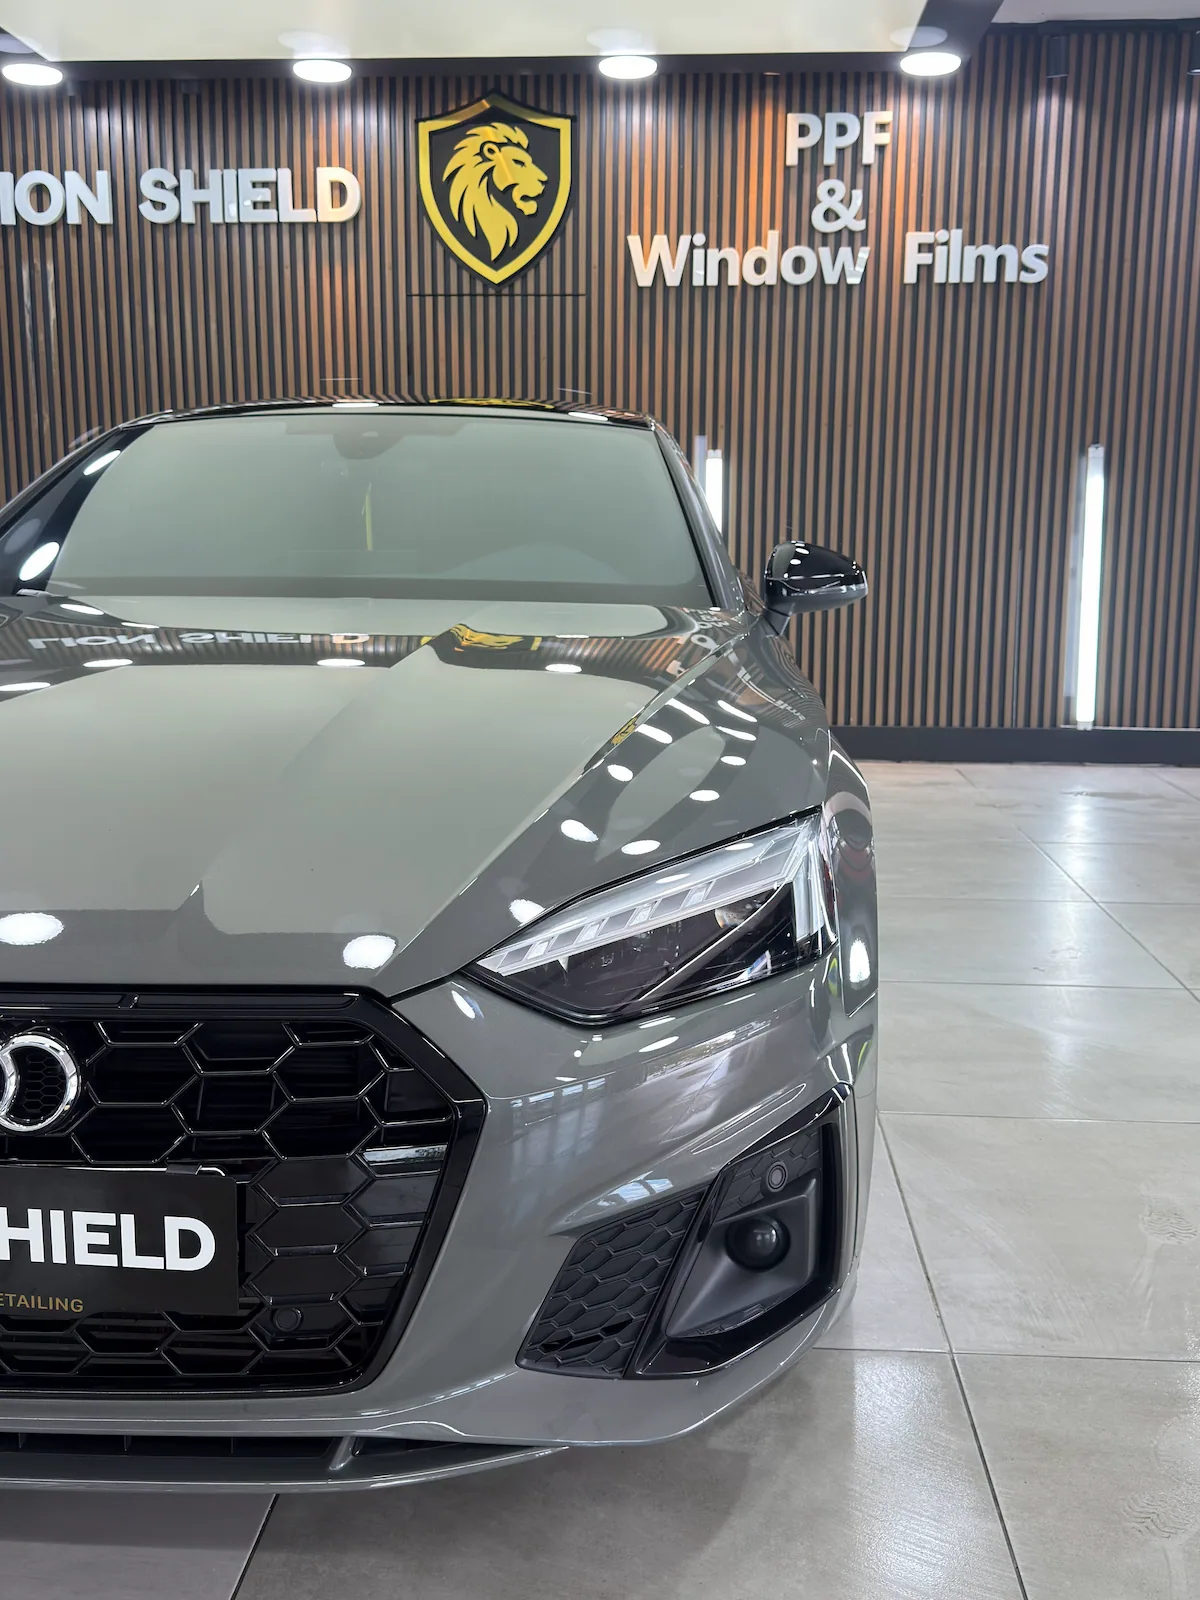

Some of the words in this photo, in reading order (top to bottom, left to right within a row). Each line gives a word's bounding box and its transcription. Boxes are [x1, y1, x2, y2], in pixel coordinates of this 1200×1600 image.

[785, 110, 894, 167] PPF
[0, 170, 113, 226] ION
[138, 166, 361, 224] SHIELD
[811, 178, 867, 233] &
[627, 229, 870, 287] Window
[903, 228, 1050, 284] Films
